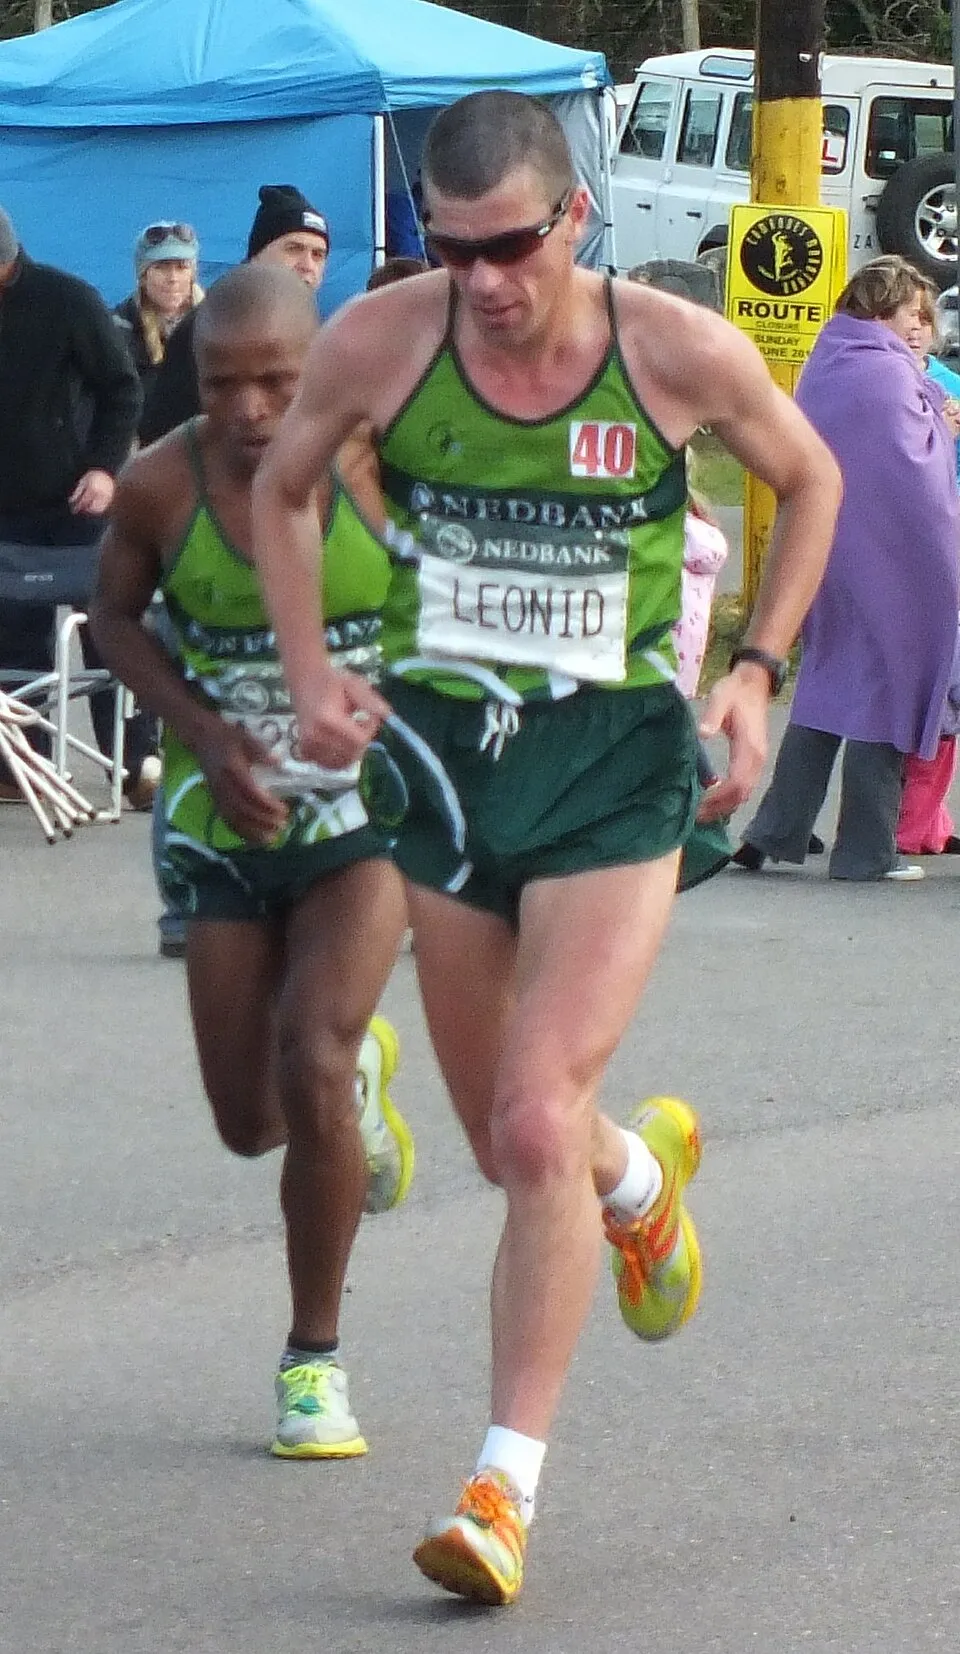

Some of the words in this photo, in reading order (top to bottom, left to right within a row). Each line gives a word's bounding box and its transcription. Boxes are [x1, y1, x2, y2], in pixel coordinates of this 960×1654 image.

[738, 301, 821, 322] ROUTE
[754, 334, 799, 346] SUNDAY
[571, 424, 636, 476] 40
[482, 538, 611, 565] NEDBANK
[453, 579, 605, 640] LEONID
